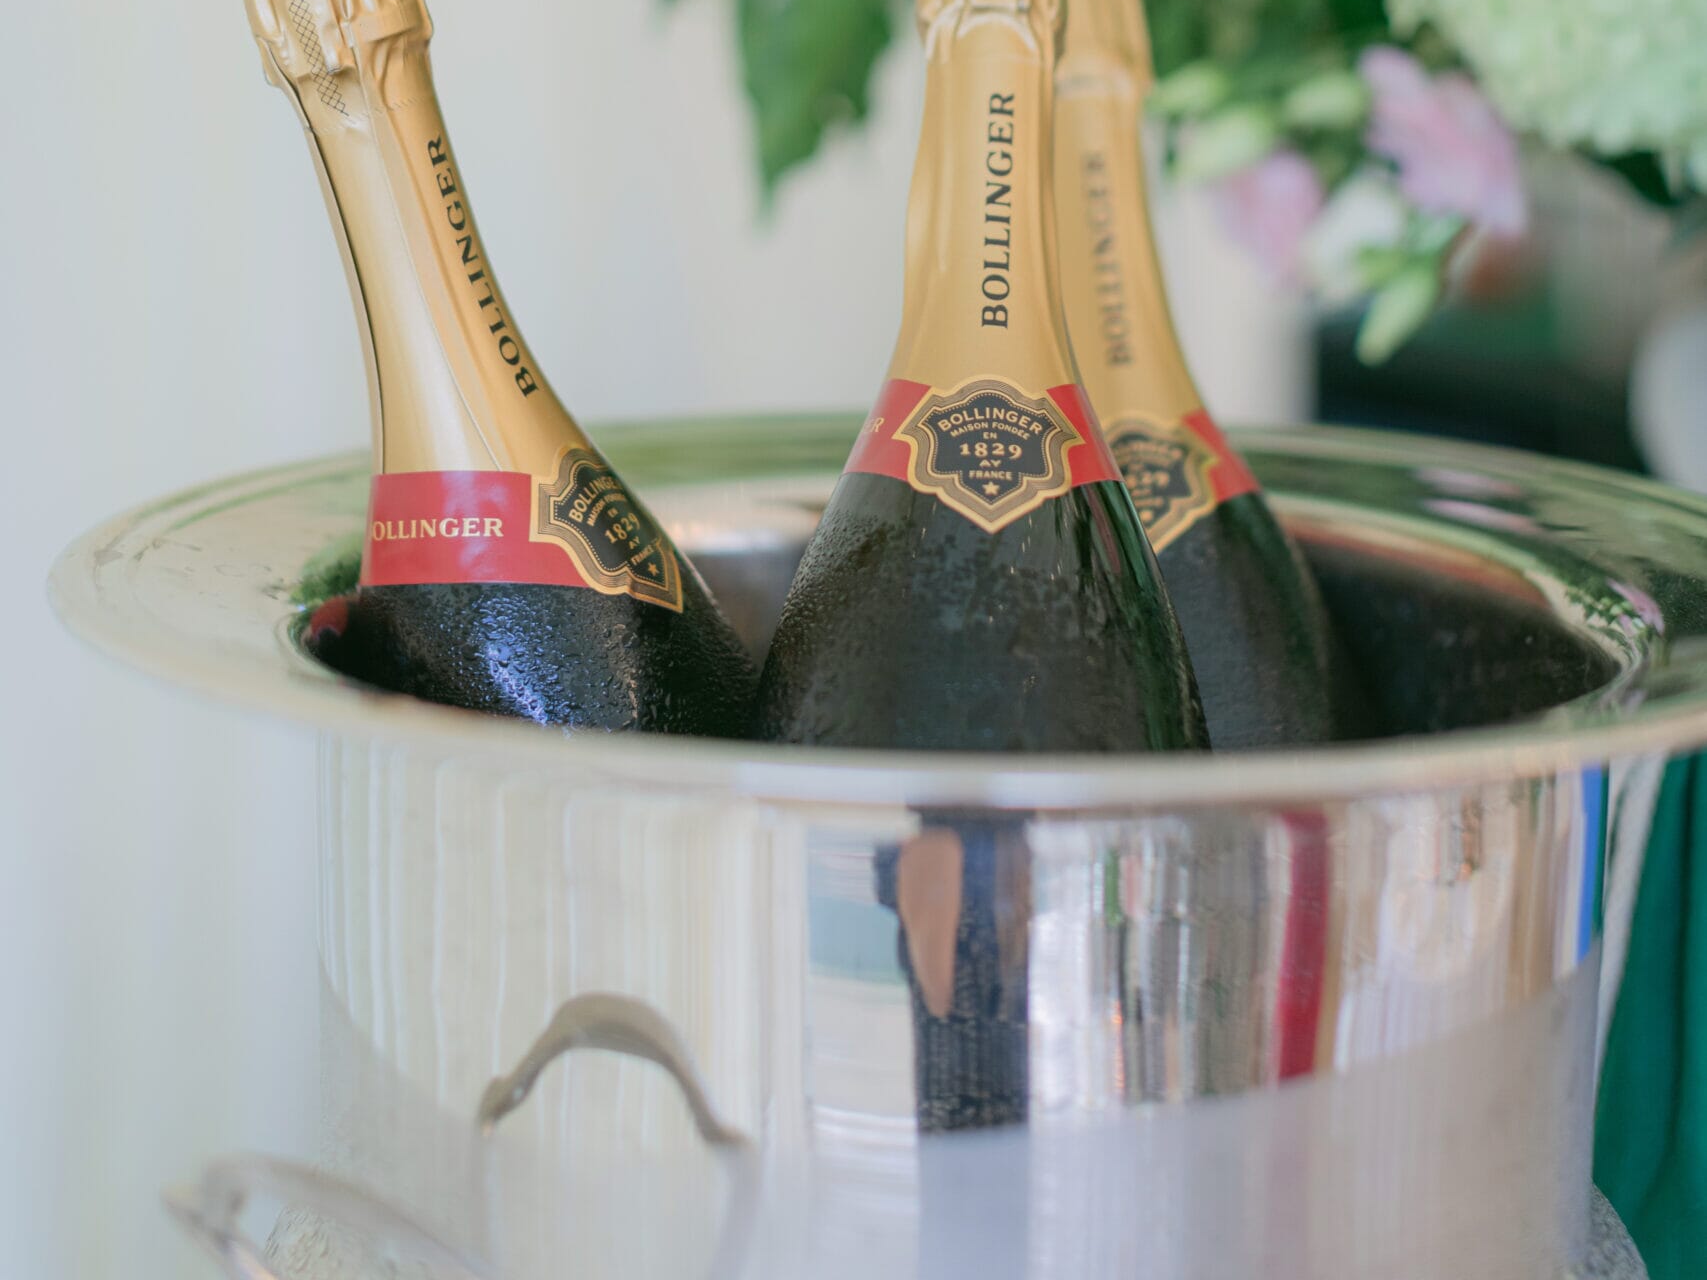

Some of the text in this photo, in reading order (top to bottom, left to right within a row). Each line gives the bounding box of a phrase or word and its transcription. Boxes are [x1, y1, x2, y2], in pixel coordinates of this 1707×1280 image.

[981, 92, 1015, 329] BOLLINGER
[427, 135, 538, 397] BOLLINGER
[938, 407, 1042, 434] BOLLINGER
[950, 422, 989, 437] MAISON
[983, 432, 998, 440] EN
[960, 442, 1023, 460] 1829
[969, 470, 1013, 480] FRANCE
[568, 476, 621, 523] BOLLINGE
[371, 518, 504, 541] OLLINGER
[605, 512, 641, 544] 1829
[628, 536, 640, 550] AY
